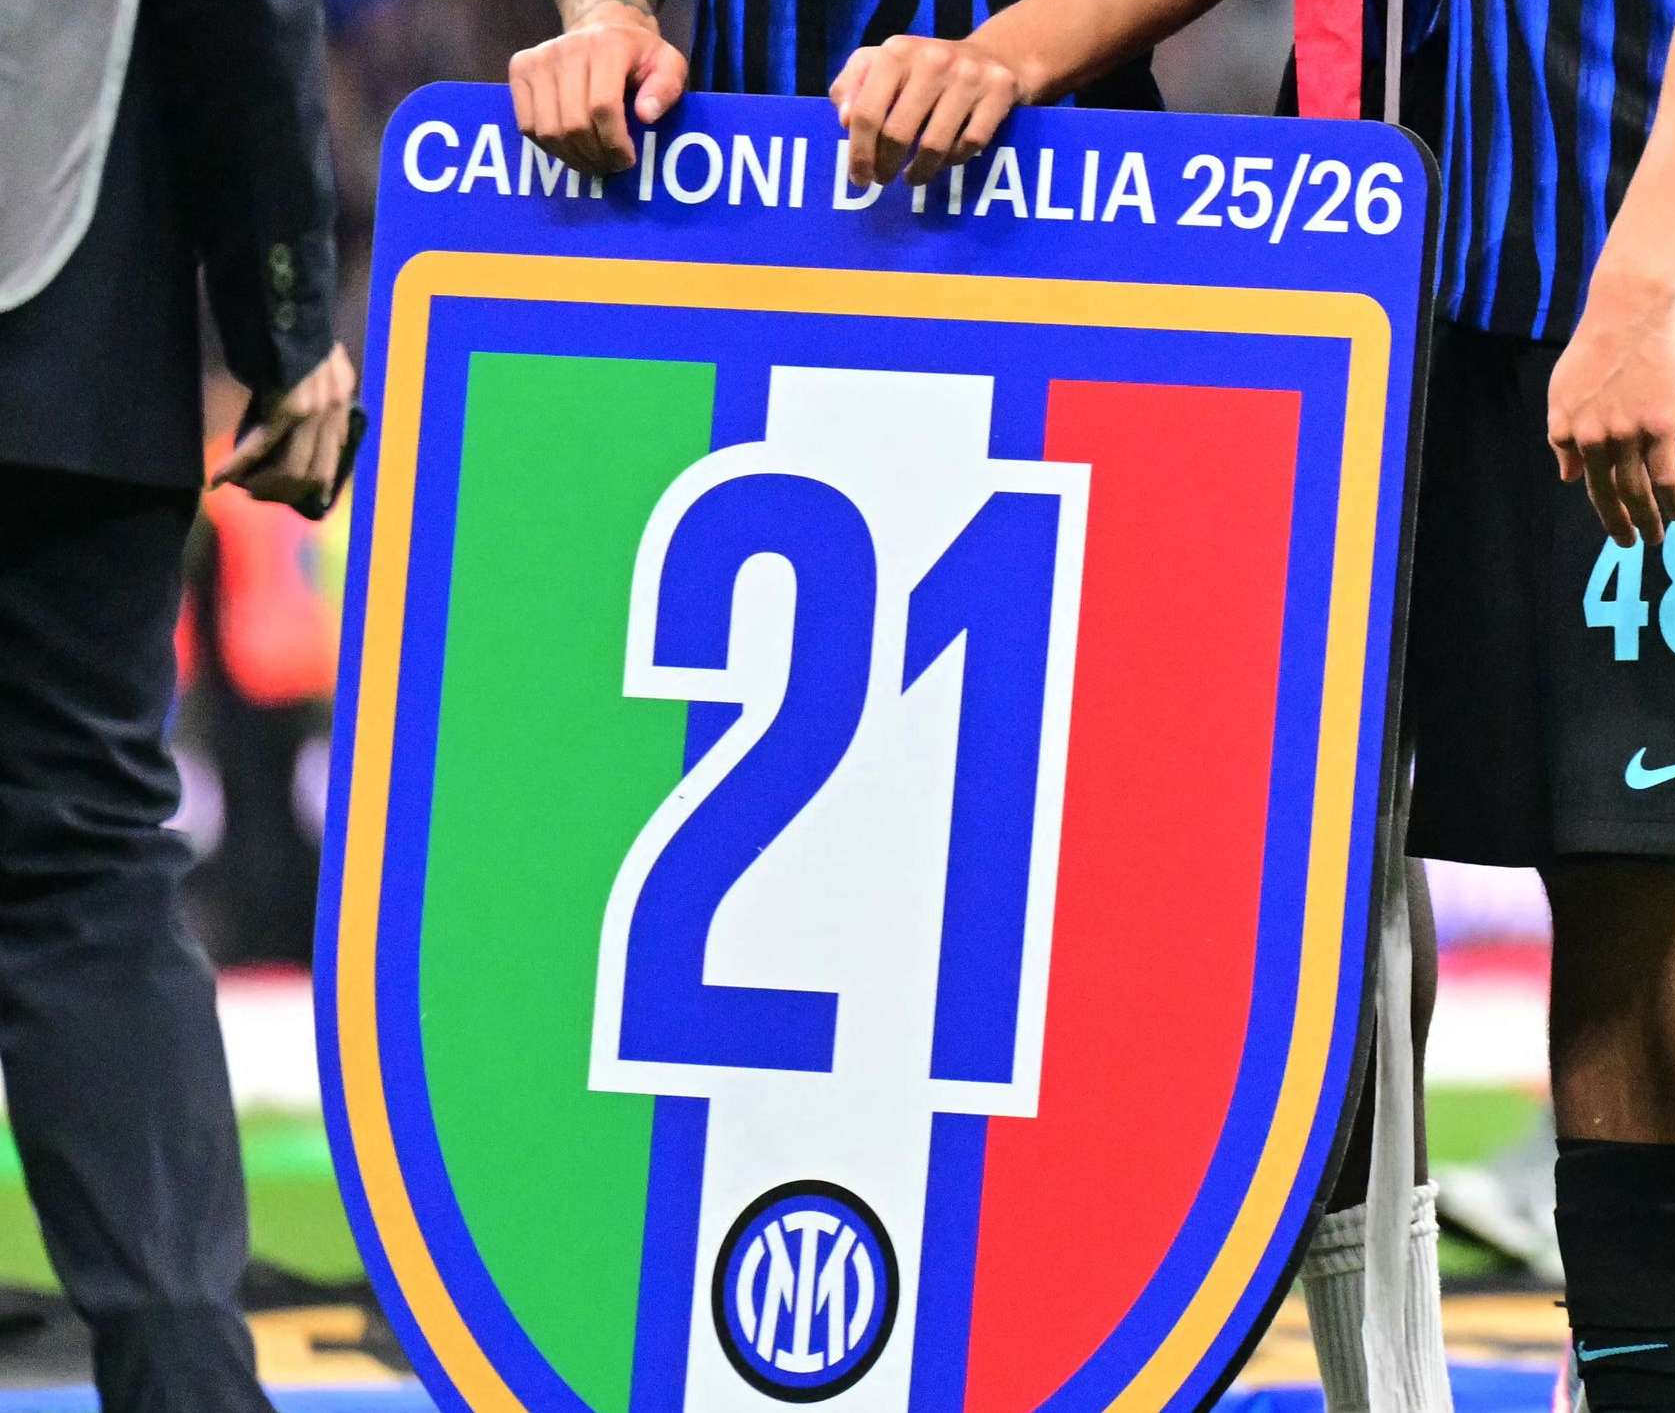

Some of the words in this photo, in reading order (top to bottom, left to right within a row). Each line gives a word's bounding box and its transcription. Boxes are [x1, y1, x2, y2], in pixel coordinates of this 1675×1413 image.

[402, 119, 809, 209] CAMIONI
[832, 138, 1157, 225] DALIA
[1176, 153, 1404, 245] 25/26
[617, 471, 1063, 1086] 21
